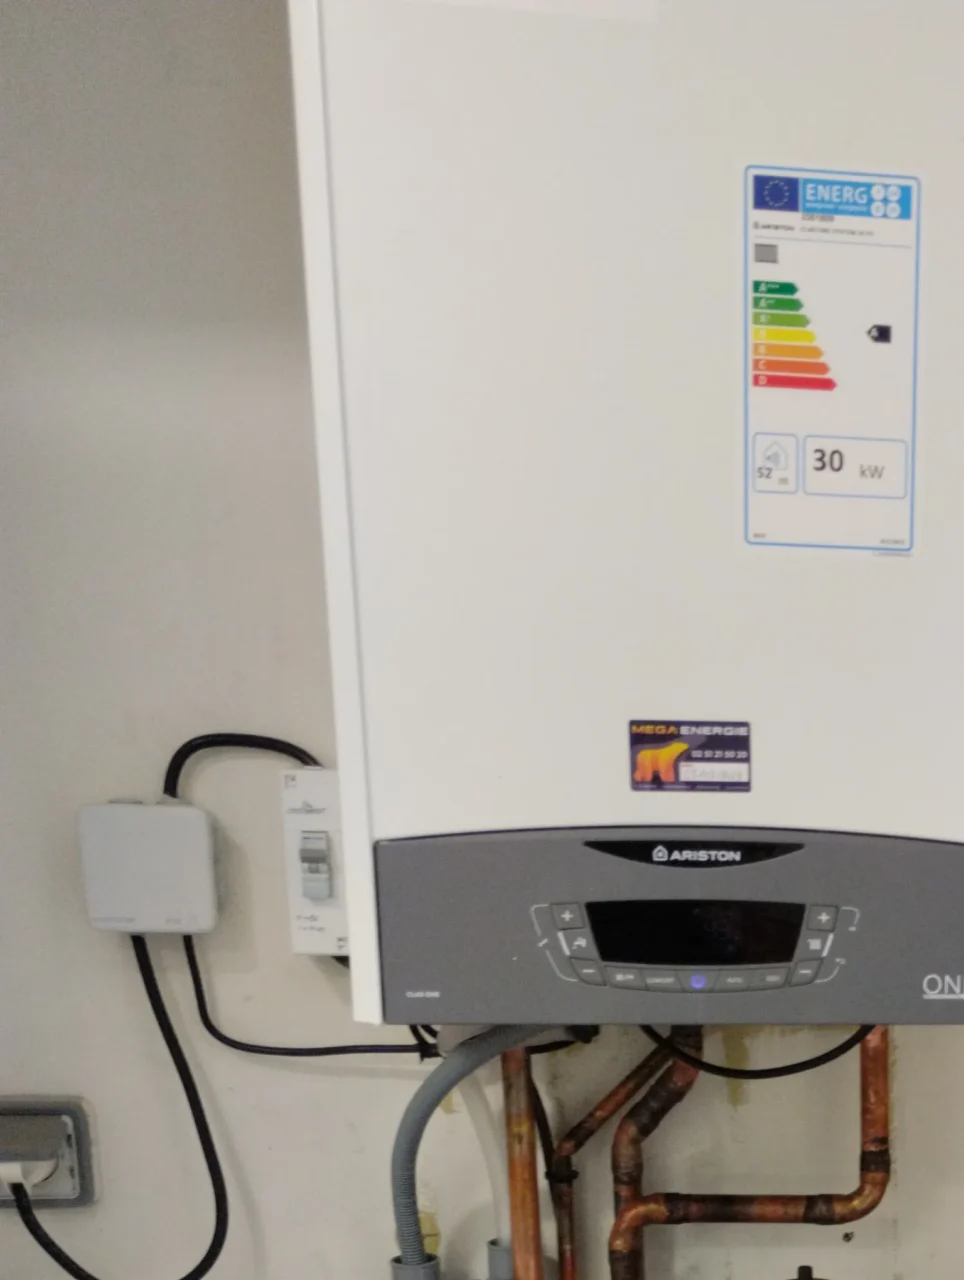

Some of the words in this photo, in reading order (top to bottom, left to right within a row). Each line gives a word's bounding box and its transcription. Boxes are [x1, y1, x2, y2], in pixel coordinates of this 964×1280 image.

[805, 183, 868, 204] ENERG
[812, 448, 844, 473] 30
[859, 464, 886, 480] kW
[756, 466, 773, 479] 52
[631, 724, 678, 735] MEGA
[679, 725, 750, 736] ENERGIE
[670, 849, 742, 861] ARISTON
